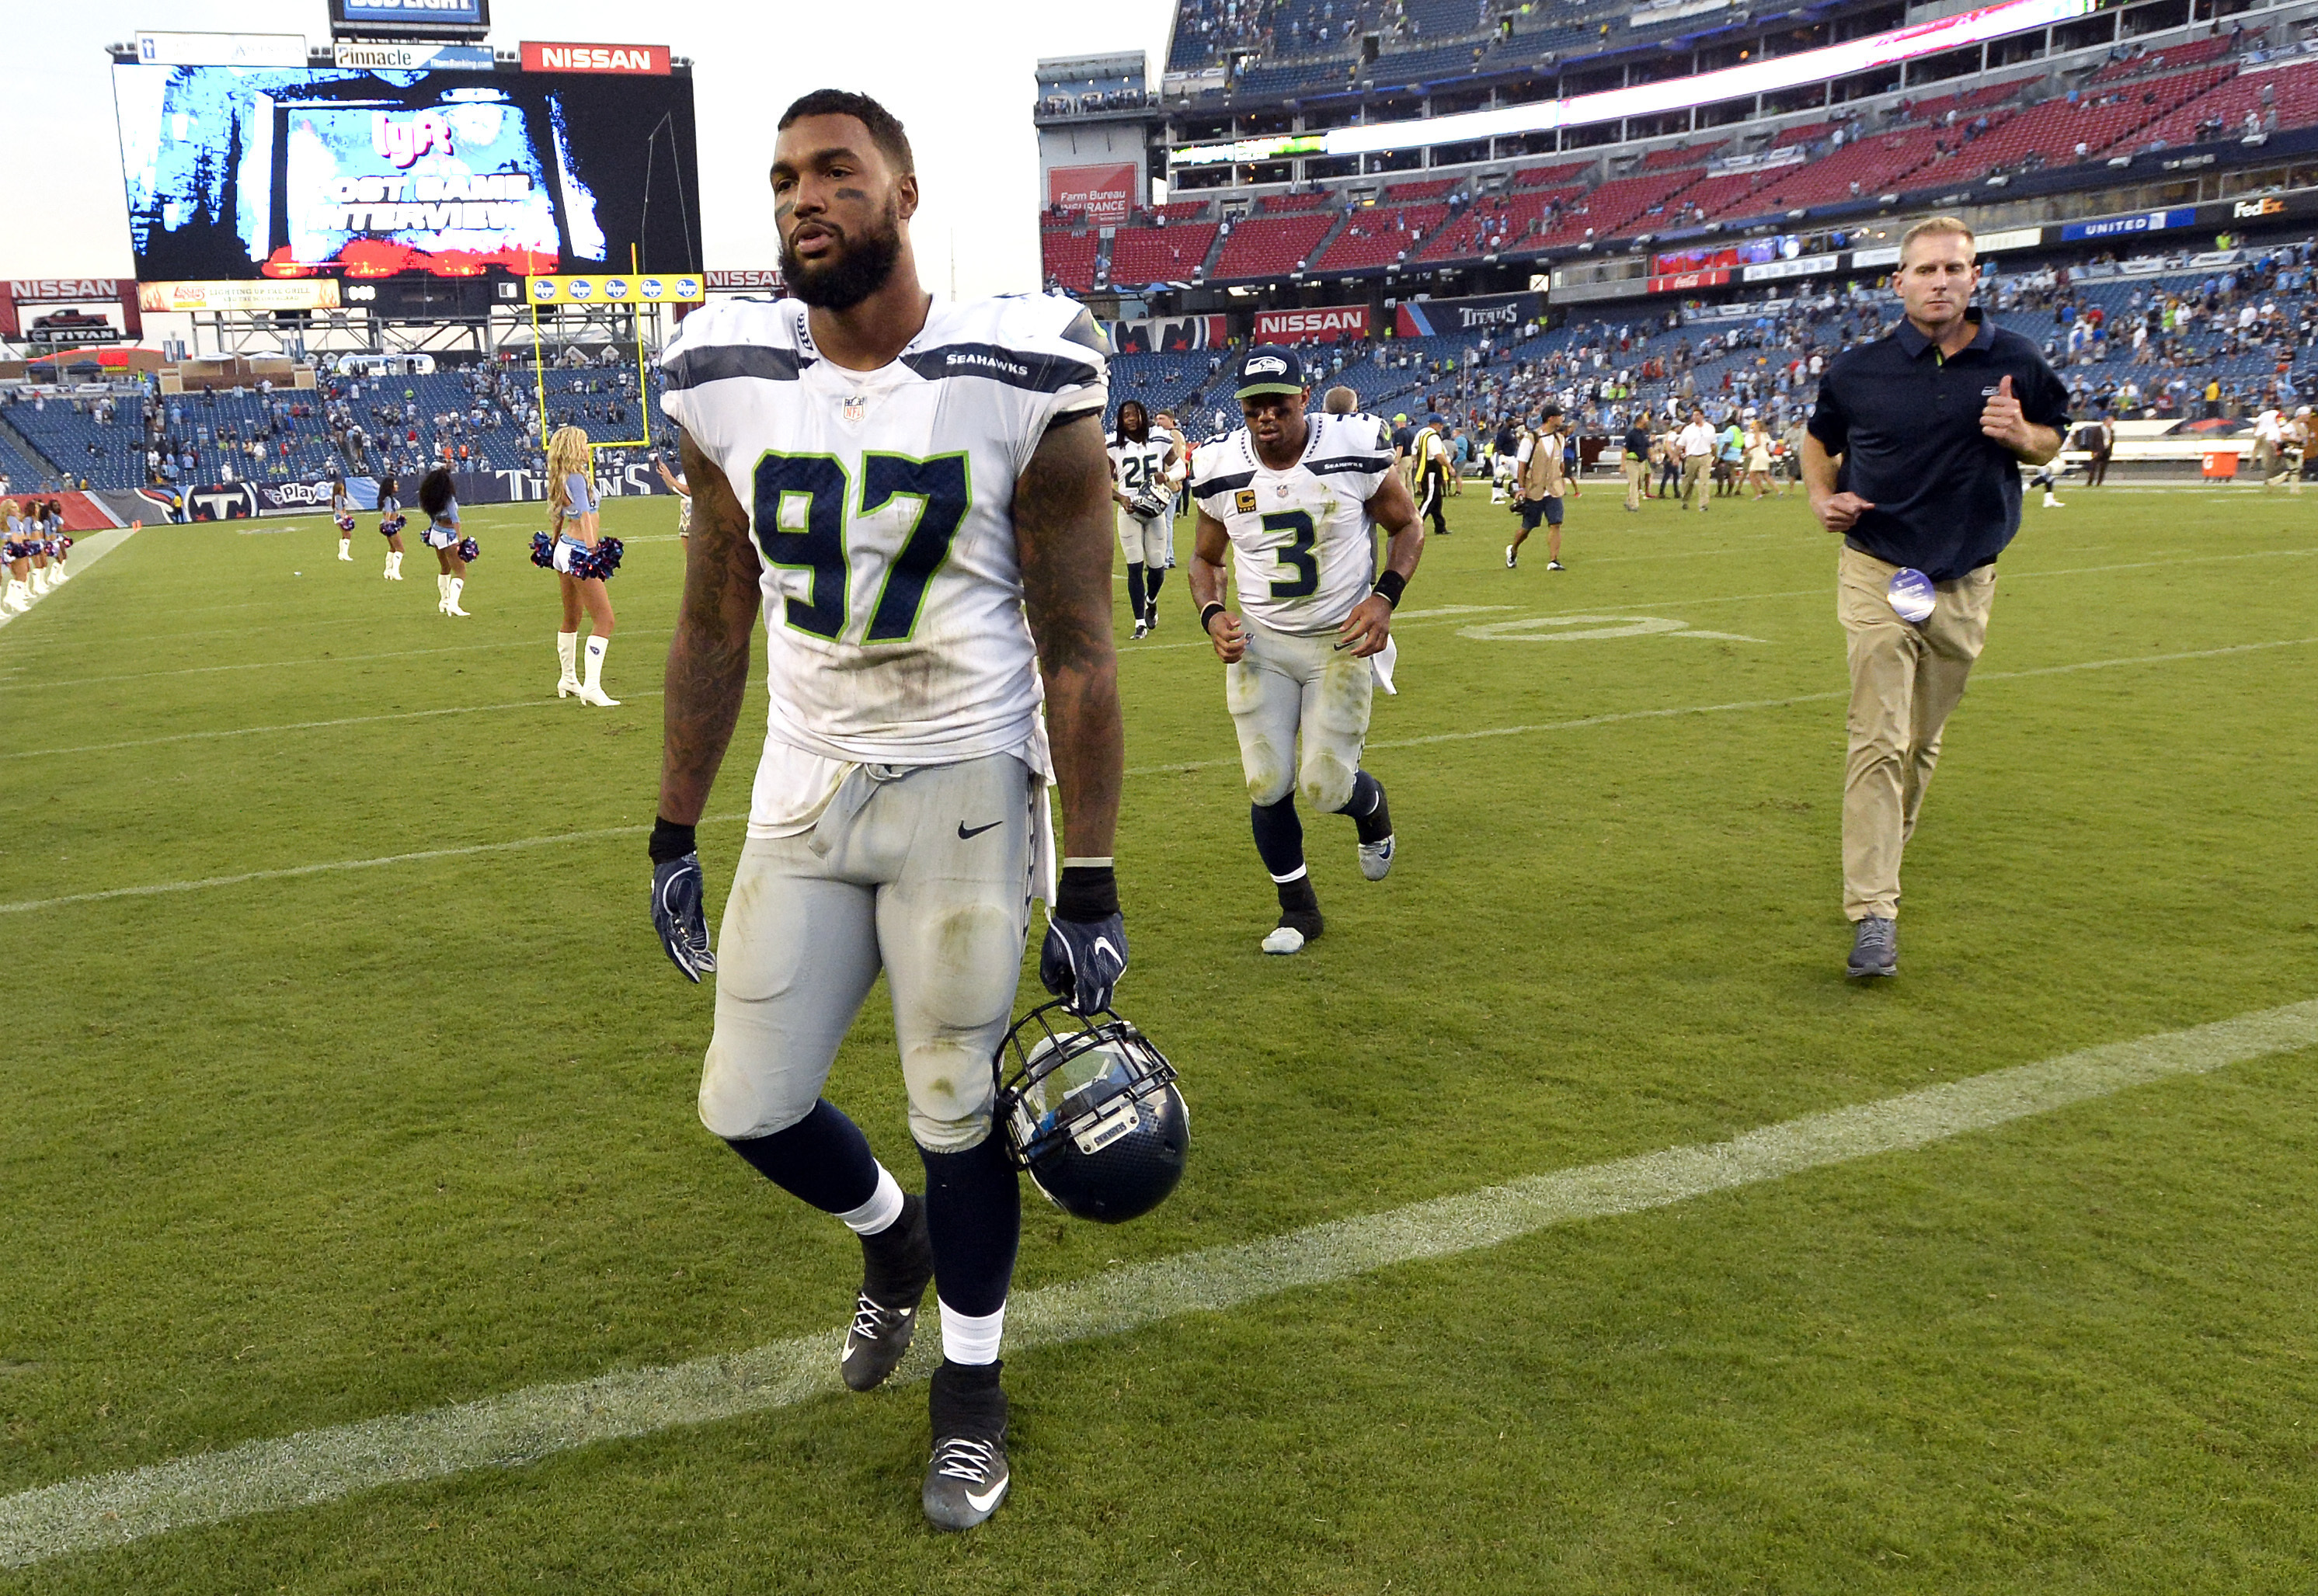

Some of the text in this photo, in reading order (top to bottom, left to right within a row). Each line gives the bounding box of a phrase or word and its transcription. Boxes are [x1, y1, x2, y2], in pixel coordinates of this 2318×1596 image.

[338, 47, 412, 66] Pinnacle
[541, 47, 651, 70] NISSAN
[317, 174, 534, 202] OST GAME
[1060, 190, 1126, 201] Farm Bureau
[2233, 197, 2285, 218] FedEx
[2085, 217, 2148, 235] UNITED
[10, 279, 117, 297] NISSAN
[1261, 311, 1362, 334] NISSAN
[52, 330, 114, 340] TITAN
[946, 353, 1028, 376] SEAHAWKS
[496, 464, 651, 501] TINS
[1122, 454, 1158, 488] 25
[1237, 491, 1255, 508] C
[751, 449, 973, 646] 97
[1260, 508, 1321, 600] 3
